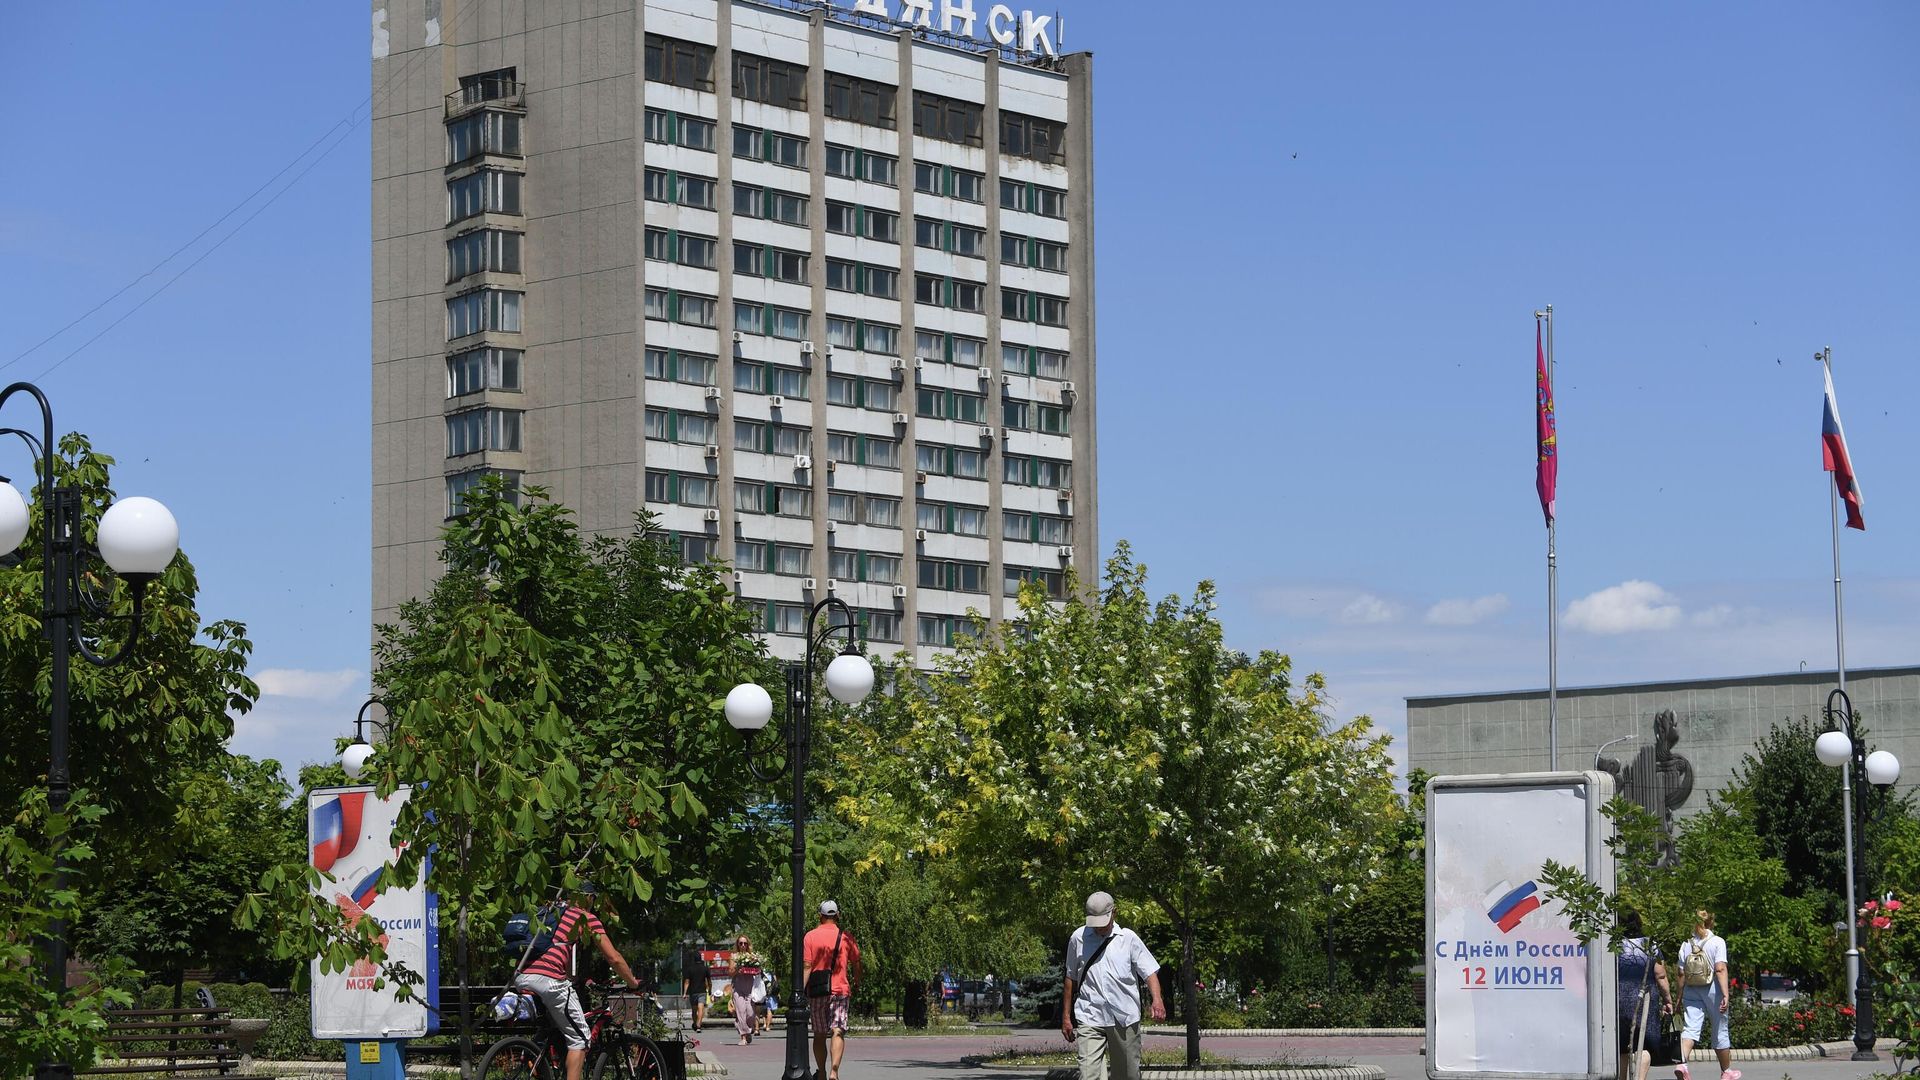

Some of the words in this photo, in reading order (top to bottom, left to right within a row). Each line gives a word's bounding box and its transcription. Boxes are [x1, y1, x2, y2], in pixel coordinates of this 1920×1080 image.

[1435, 941, 1447, 958] С
[1454, 940, 1509, 961] Днём
[1516, 941, 1588, 958] России
[1462, 967, 1487, 985] 12
[1494, 966, 1563, 985] ИЮНЯ
